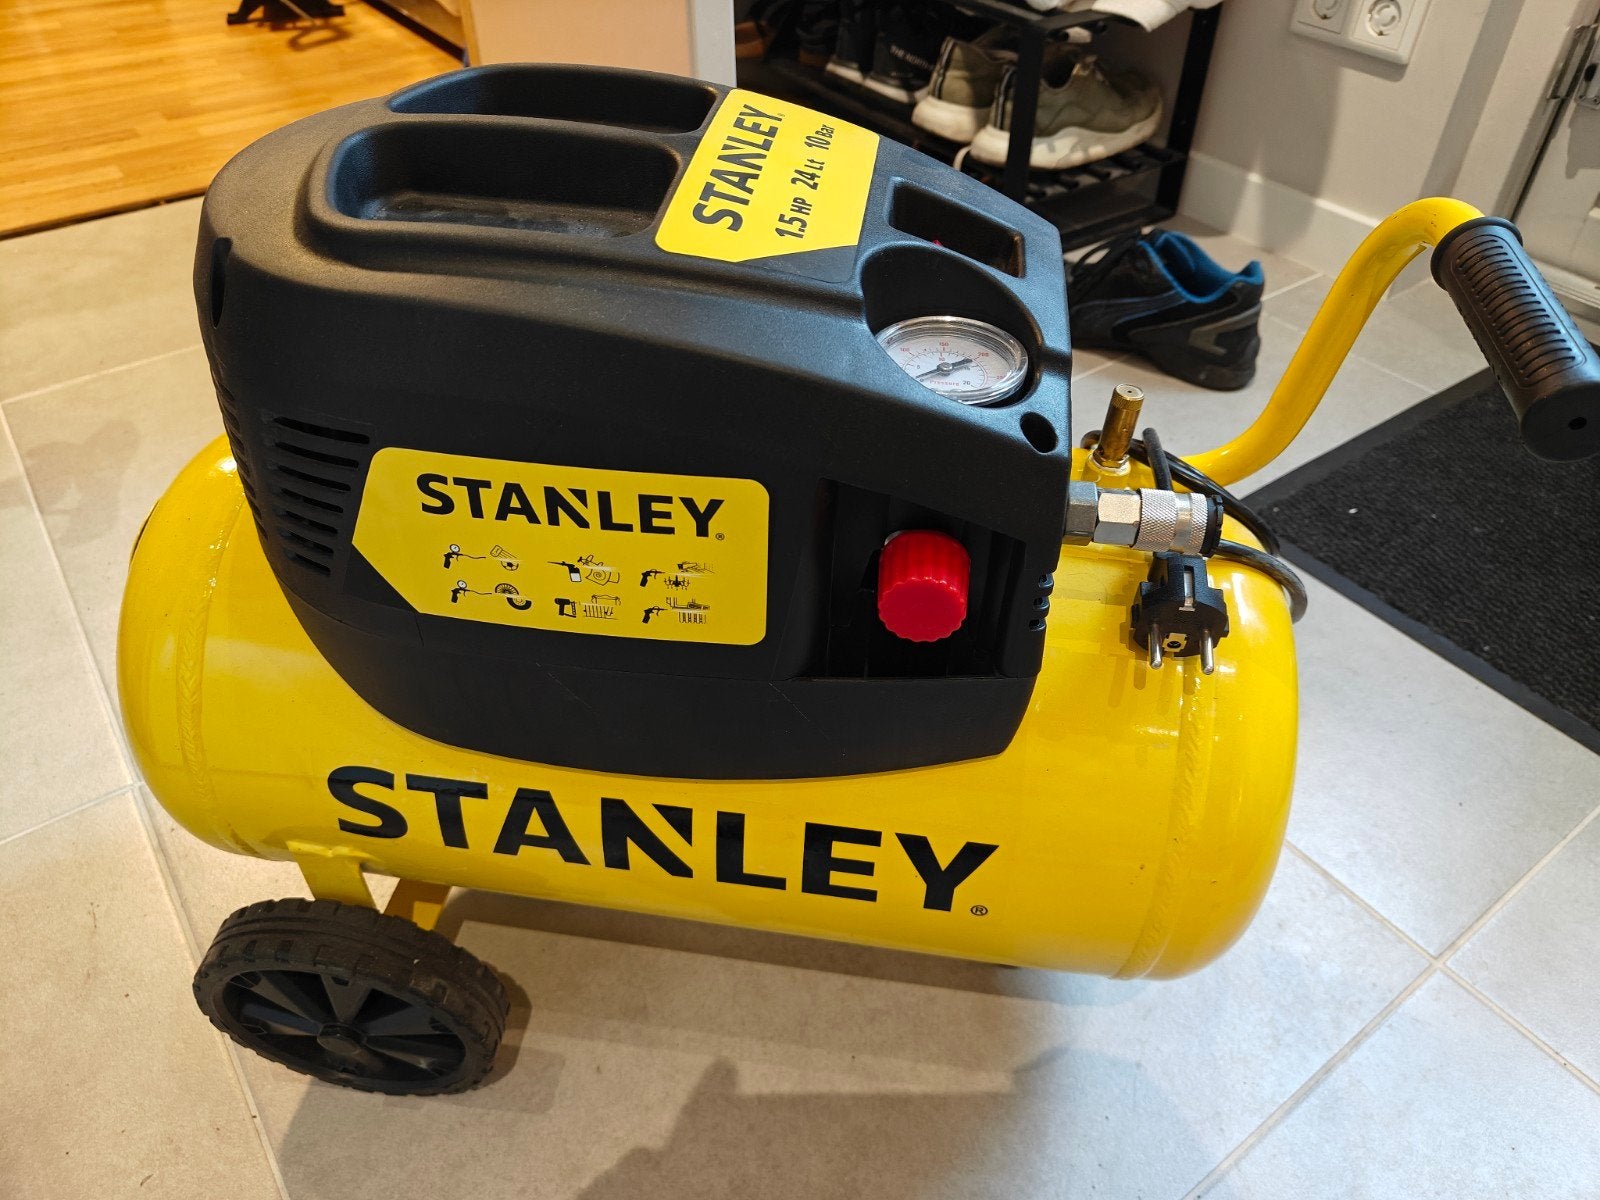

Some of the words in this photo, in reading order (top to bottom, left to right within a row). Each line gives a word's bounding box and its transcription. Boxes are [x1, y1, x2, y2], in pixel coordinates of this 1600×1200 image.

[814, 123, 836, 139] Bar
[803, 135, 831, 151] 10
[806, 158, 826, 171] Lt
[790, 169, 819, 191] 24
[789, 196, 813, 216] HP
[774, 213, 808, 239] 1.5
[417, 473, 725, 539] STANLEY
